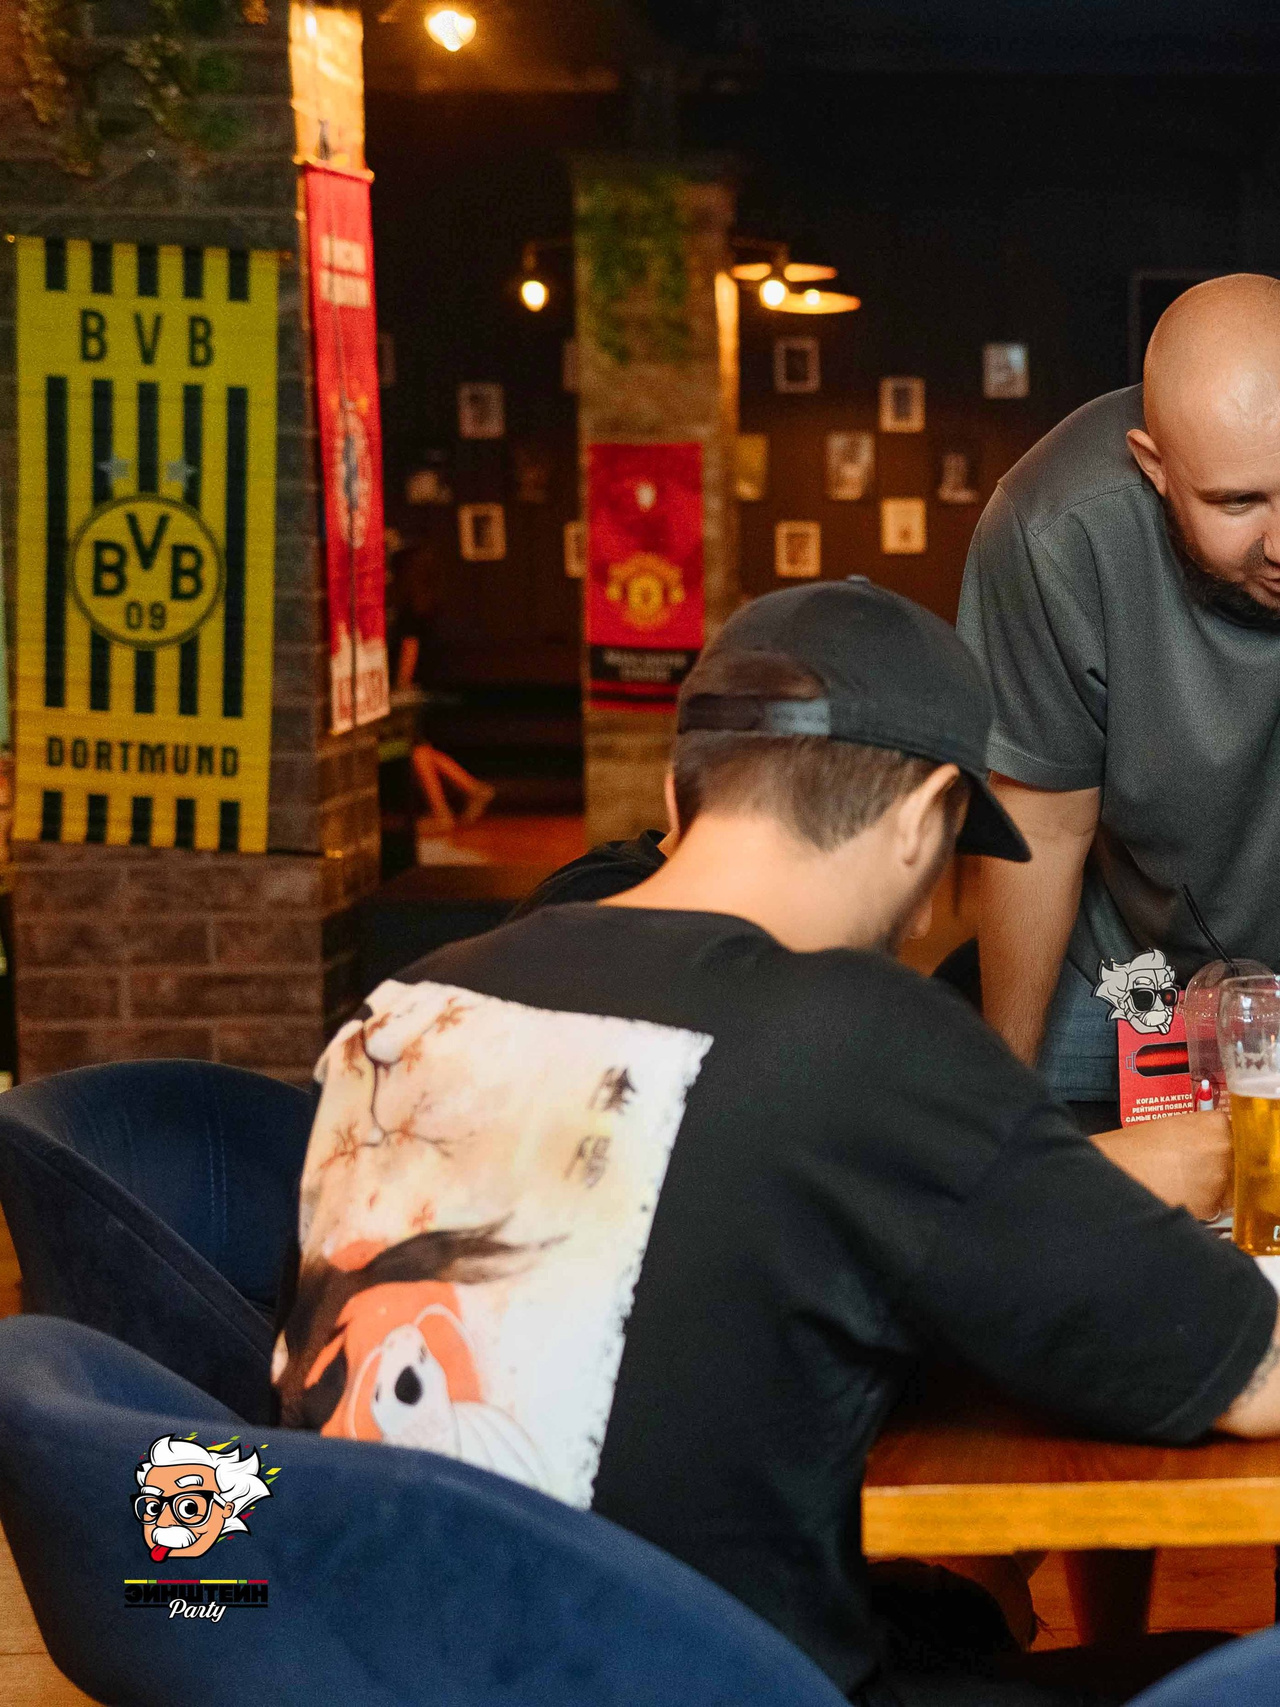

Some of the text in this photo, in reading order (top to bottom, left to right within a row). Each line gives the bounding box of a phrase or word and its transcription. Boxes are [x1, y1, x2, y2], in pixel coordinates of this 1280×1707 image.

[80, 309, 215, 368] BVB
[92, 513, 205, 601] BVB
[125, 601, 167, 631] 09
[47, 736, 239, 778] DORTMUND
[1136, 1096, 1159, 1105] КОГДА
[1164, 1101, 1193, 1111] ПОЯВЛЯ
[1125, 1113, 1152, 1123] САМЫЕ
